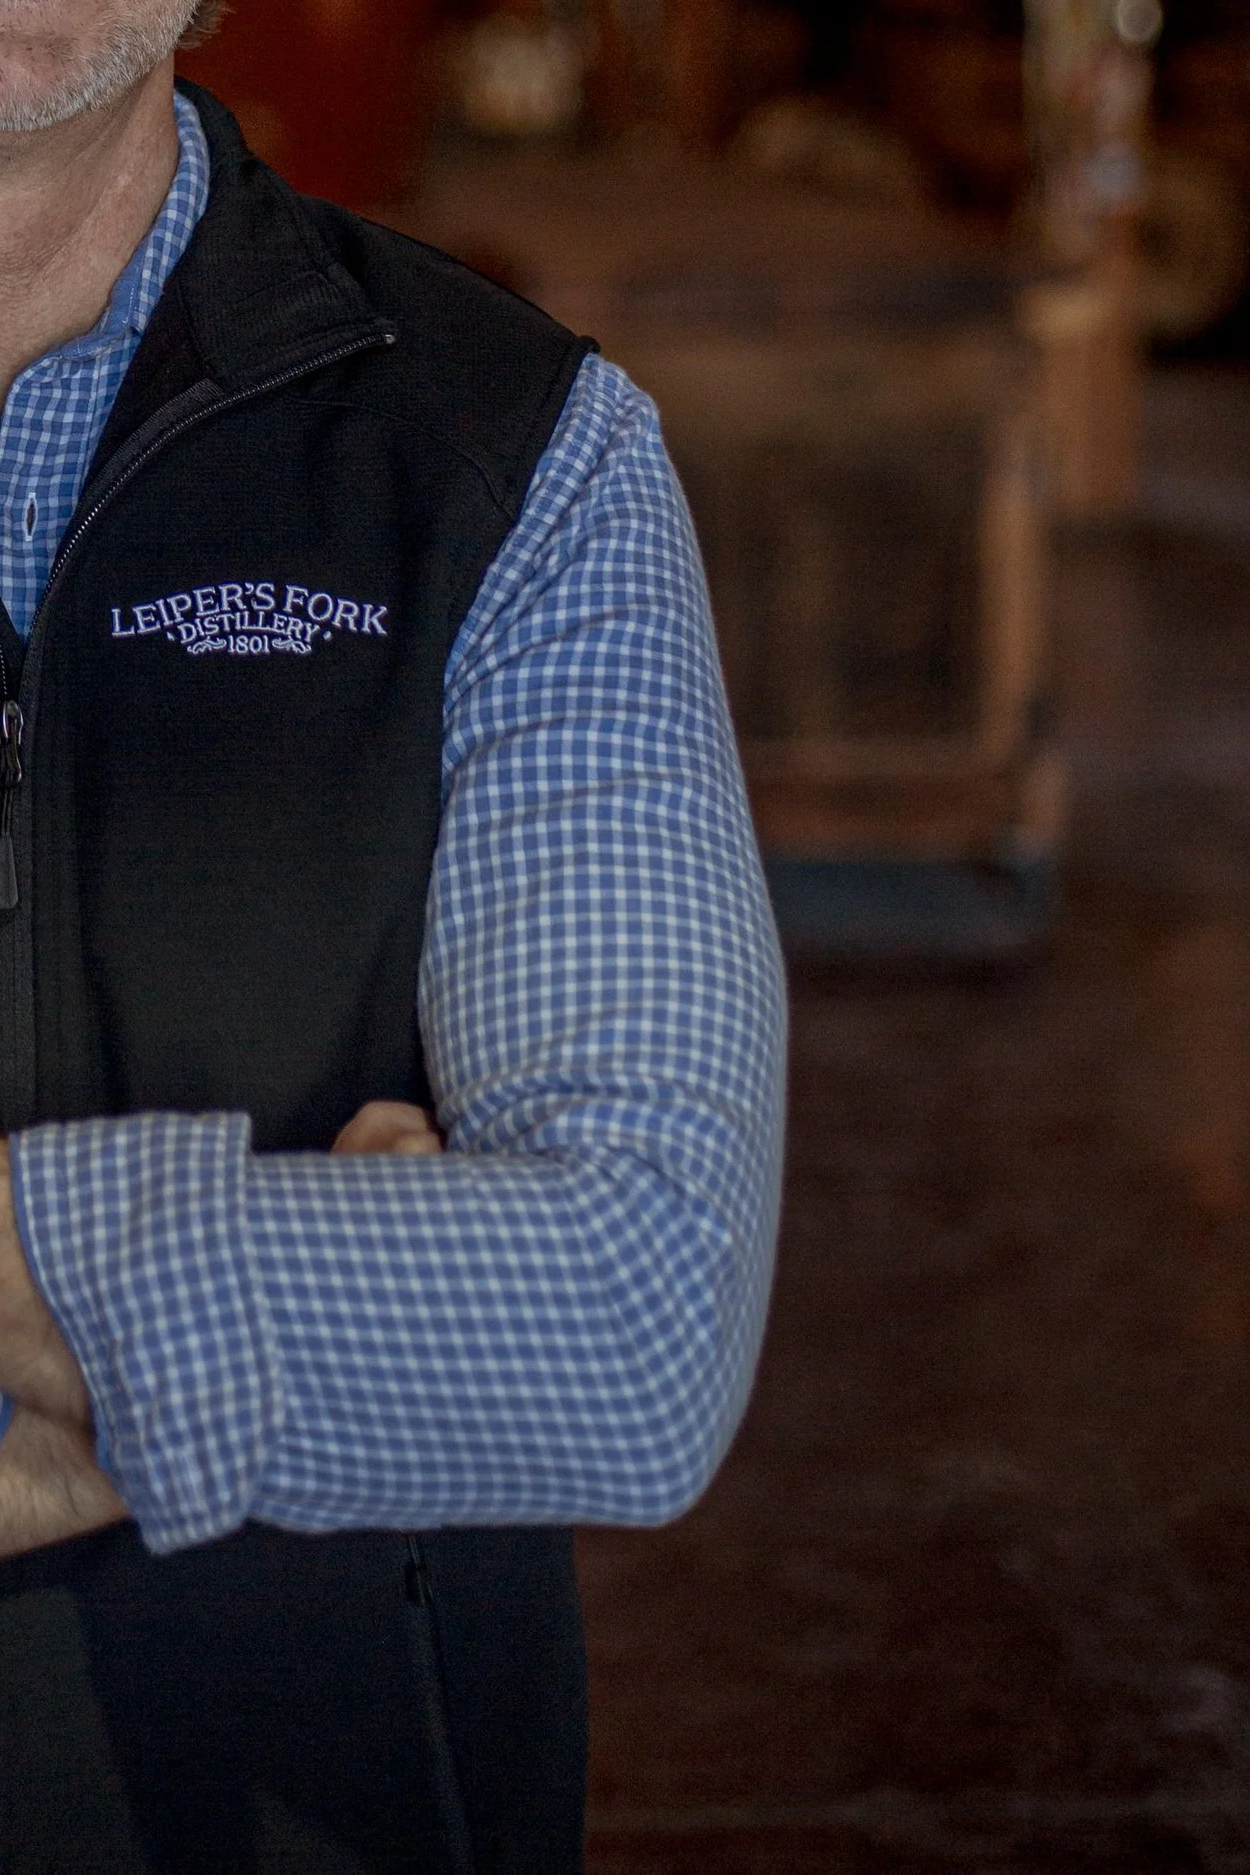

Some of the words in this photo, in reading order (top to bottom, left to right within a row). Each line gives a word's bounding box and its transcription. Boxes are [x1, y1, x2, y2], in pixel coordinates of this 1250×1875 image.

[110, 581, 277, 637] LEIPER'S
[282, 584, 389, 636] FORK
[176, 610, 320, 645] DISTILLERY
[227, 634, 270, 654] 1801
